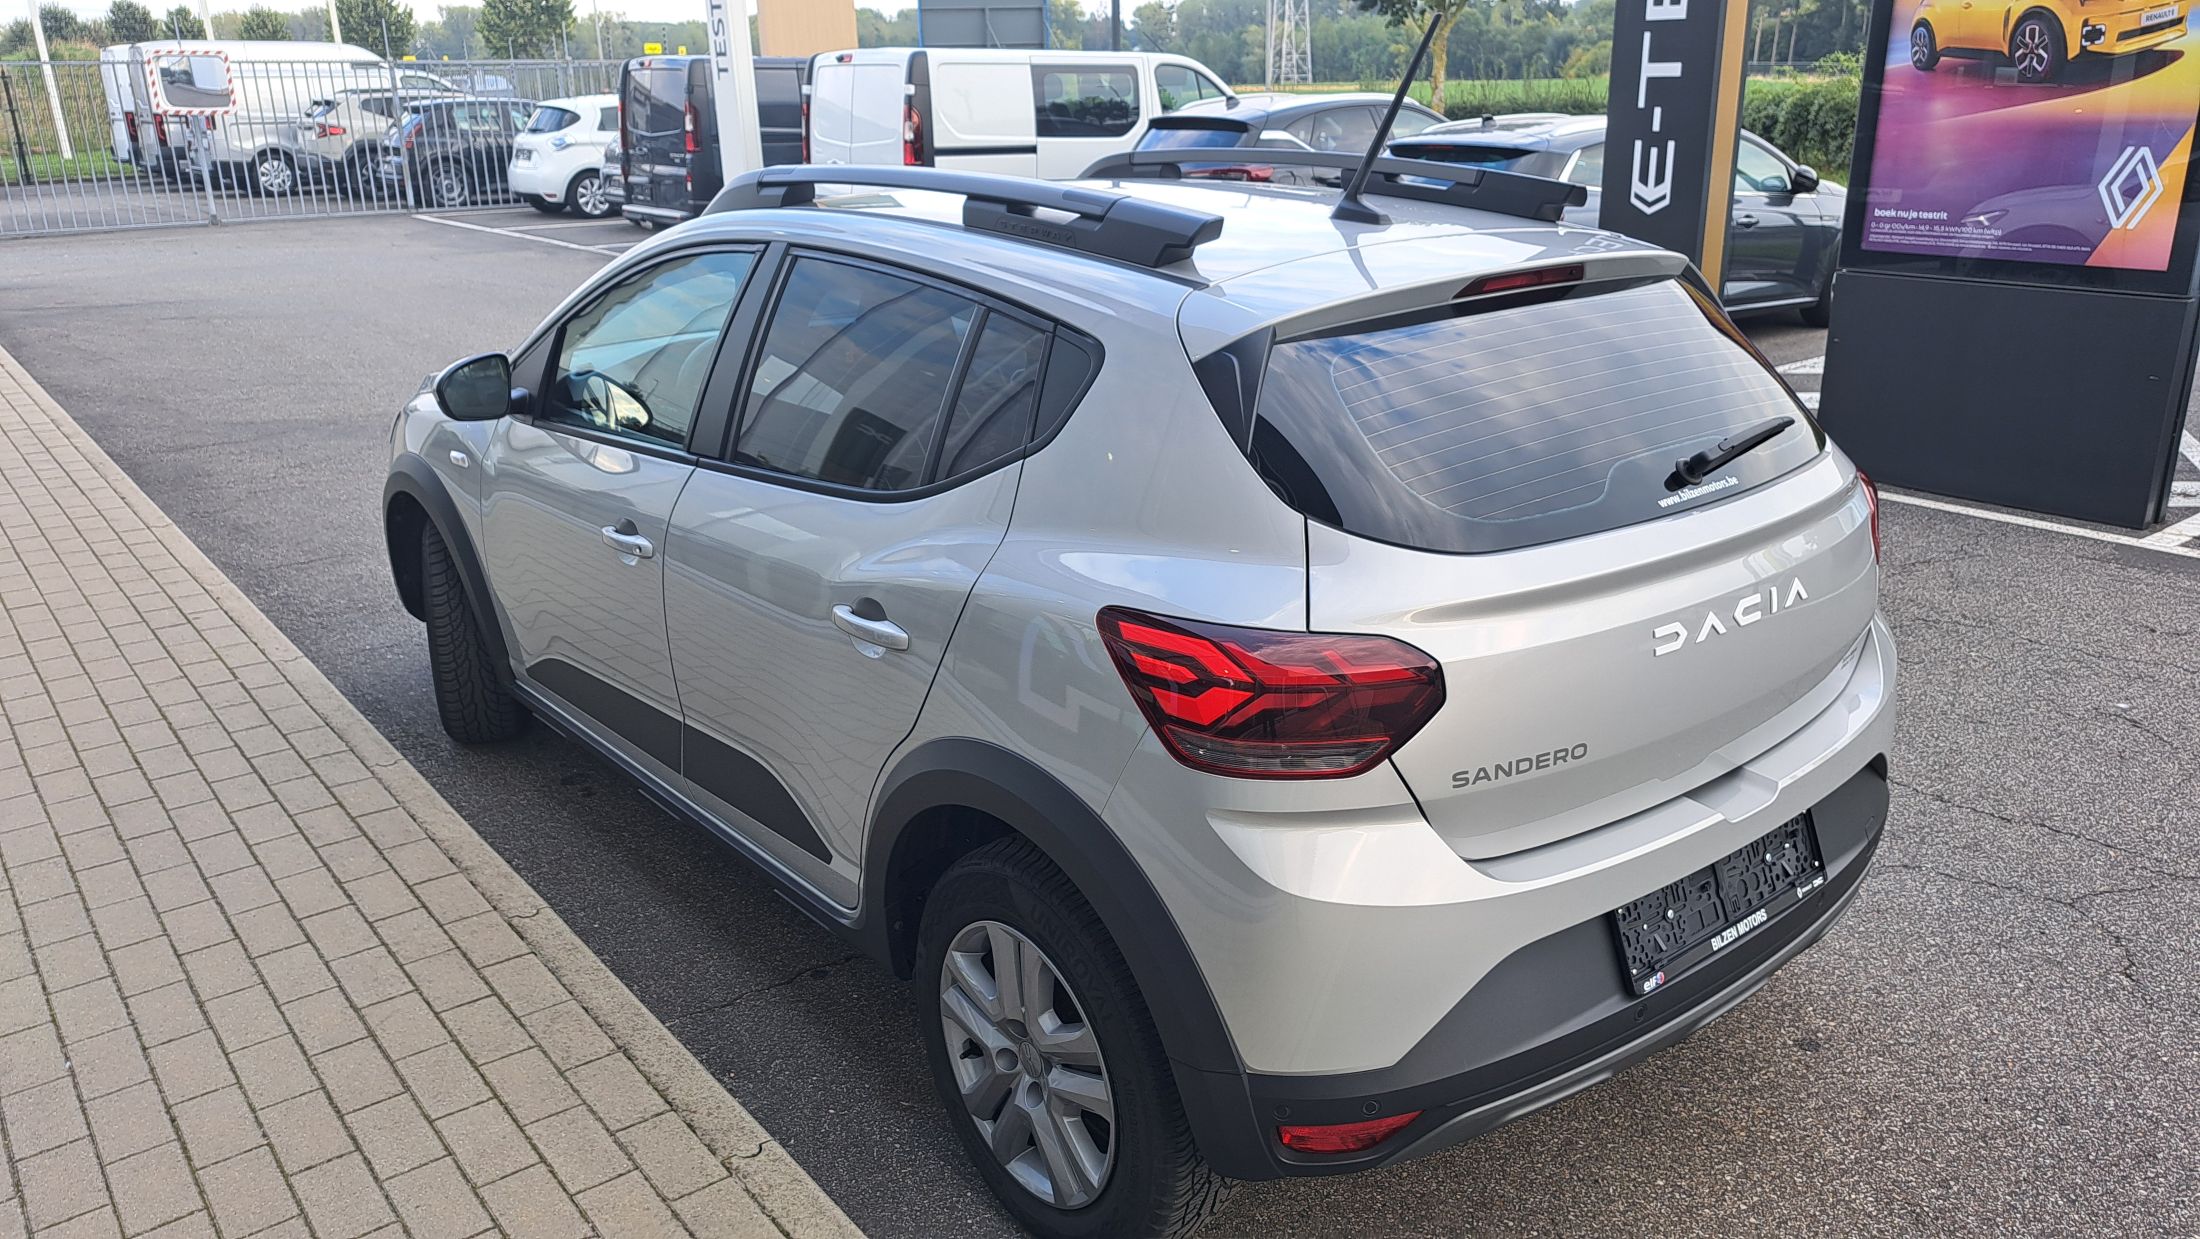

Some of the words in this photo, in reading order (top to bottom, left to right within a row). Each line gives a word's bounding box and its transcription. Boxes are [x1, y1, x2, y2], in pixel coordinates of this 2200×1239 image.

[709, 0, 728, 80] TEST
[1874, 208, 1896, 217] boek
[1897, 210, 1908, 218] nu
[1658, 475, 1739, 508] www.bilzenmotors.be
[1652, 576, 1809, 657] DACIA
[1451, 742, 1588, 789] SANDERO
[1710, 929, 1738, 951] BILZEN
[1737, 908, 1768, 938] MOTORS
[1644, 976, 1657, 990] elf
